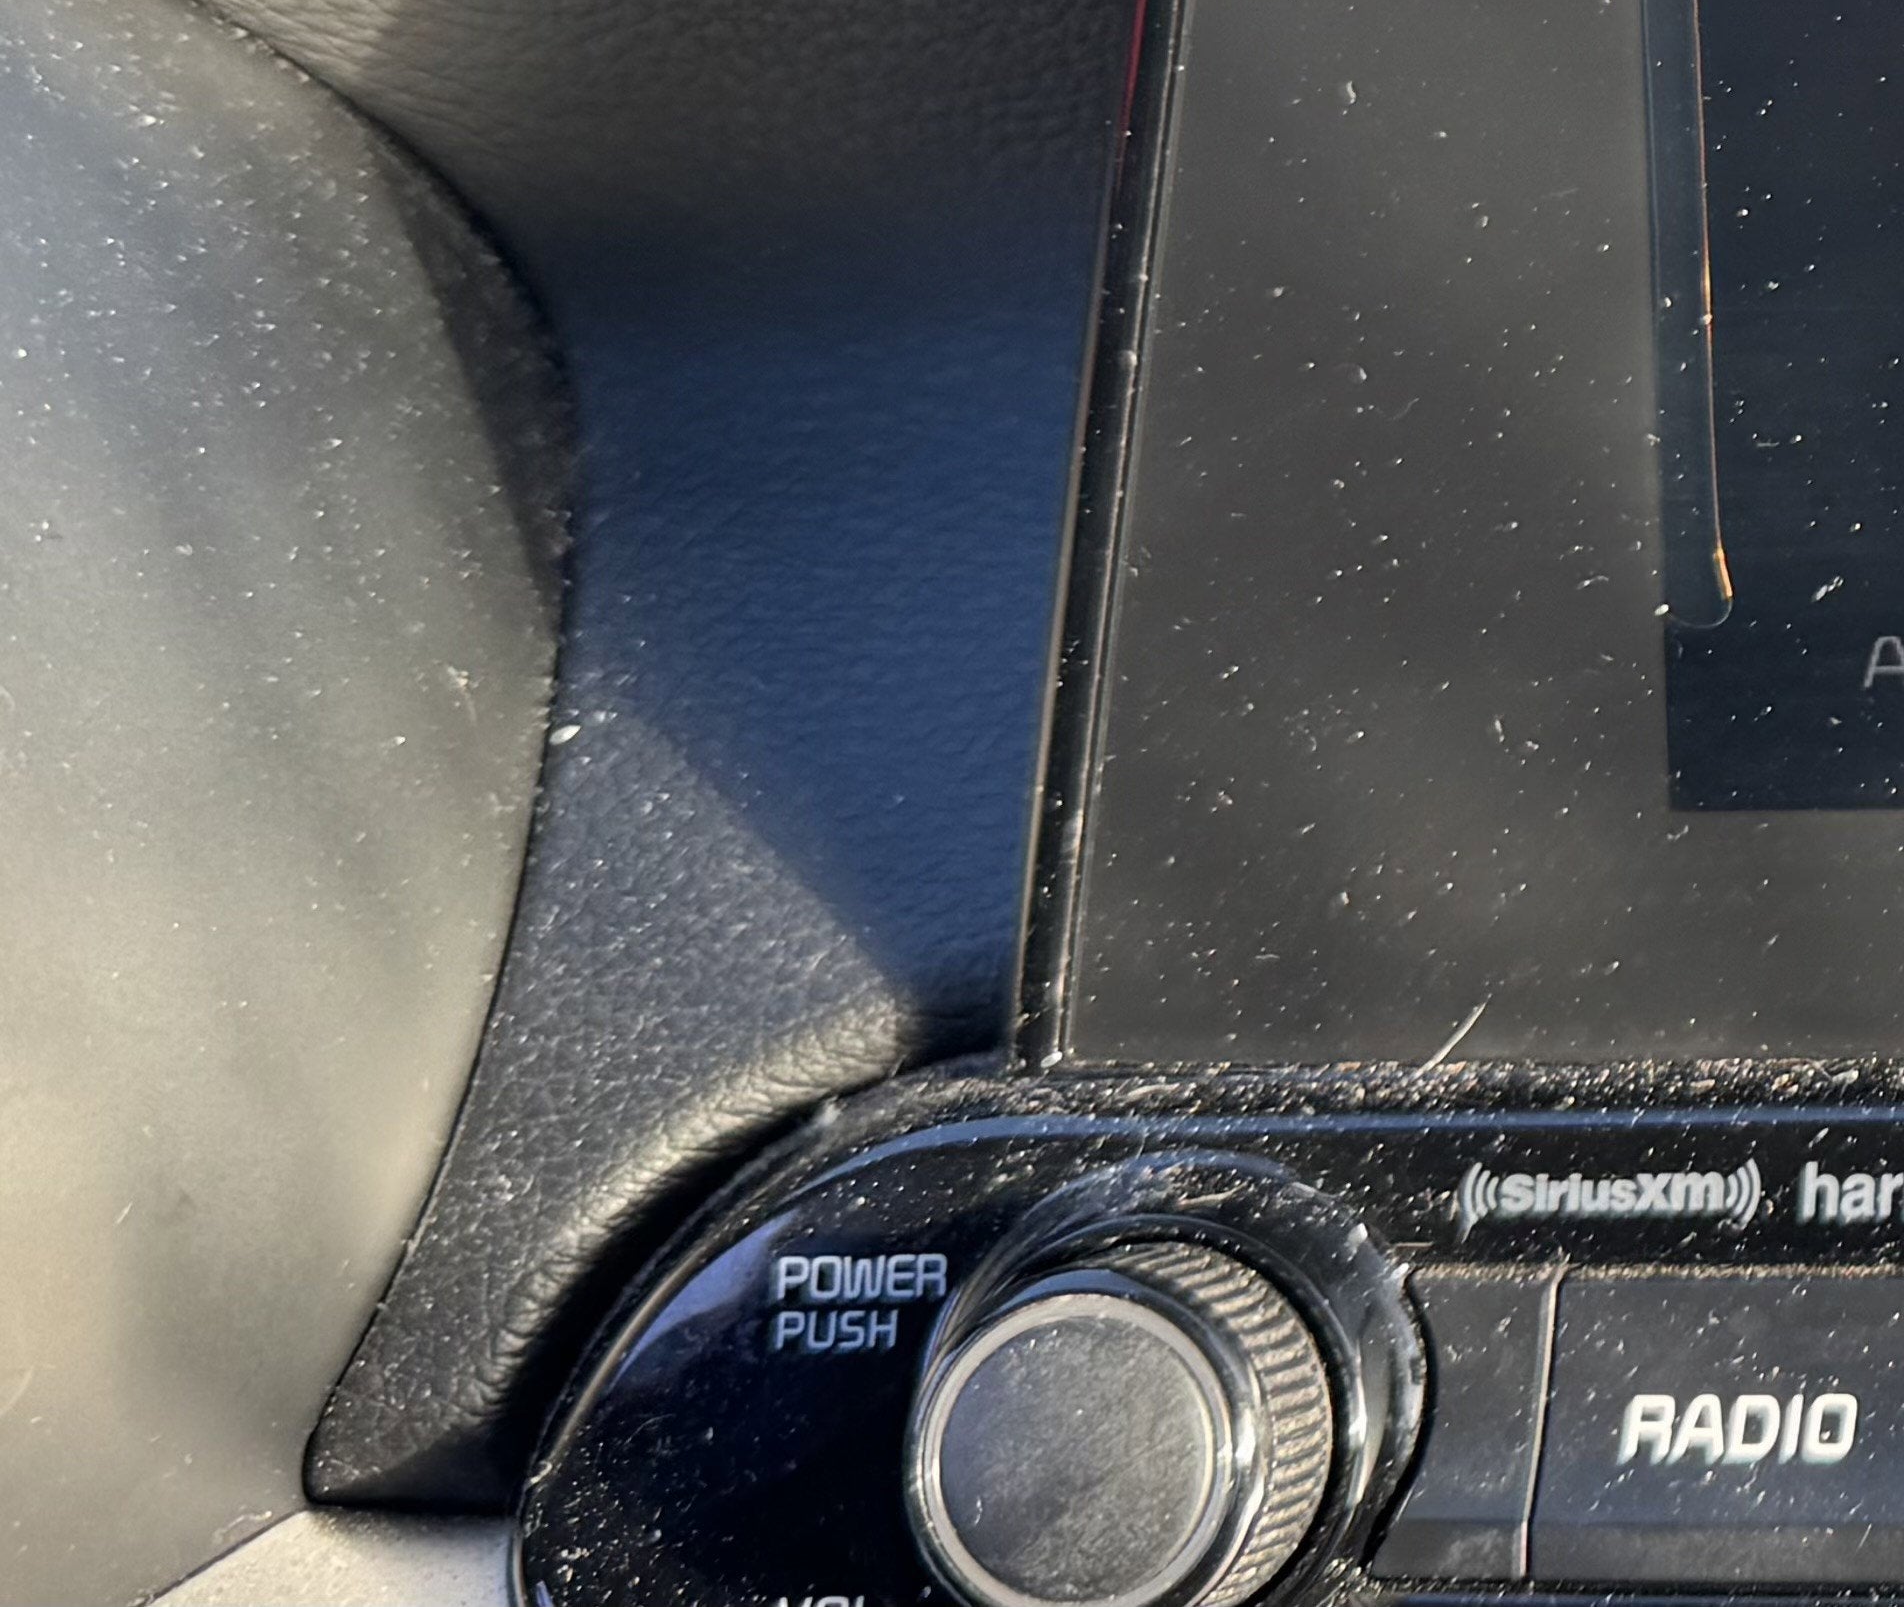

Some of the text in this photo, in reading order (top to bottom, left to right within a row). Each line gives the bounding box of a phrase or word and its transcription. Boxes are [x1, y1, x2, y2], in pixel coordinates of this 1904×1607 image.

[776, 1253, 948, 1300] POWER
[775, 1309, 898, 1351] PUSH
[1616, 1394, 1860, 1468] RADIO
